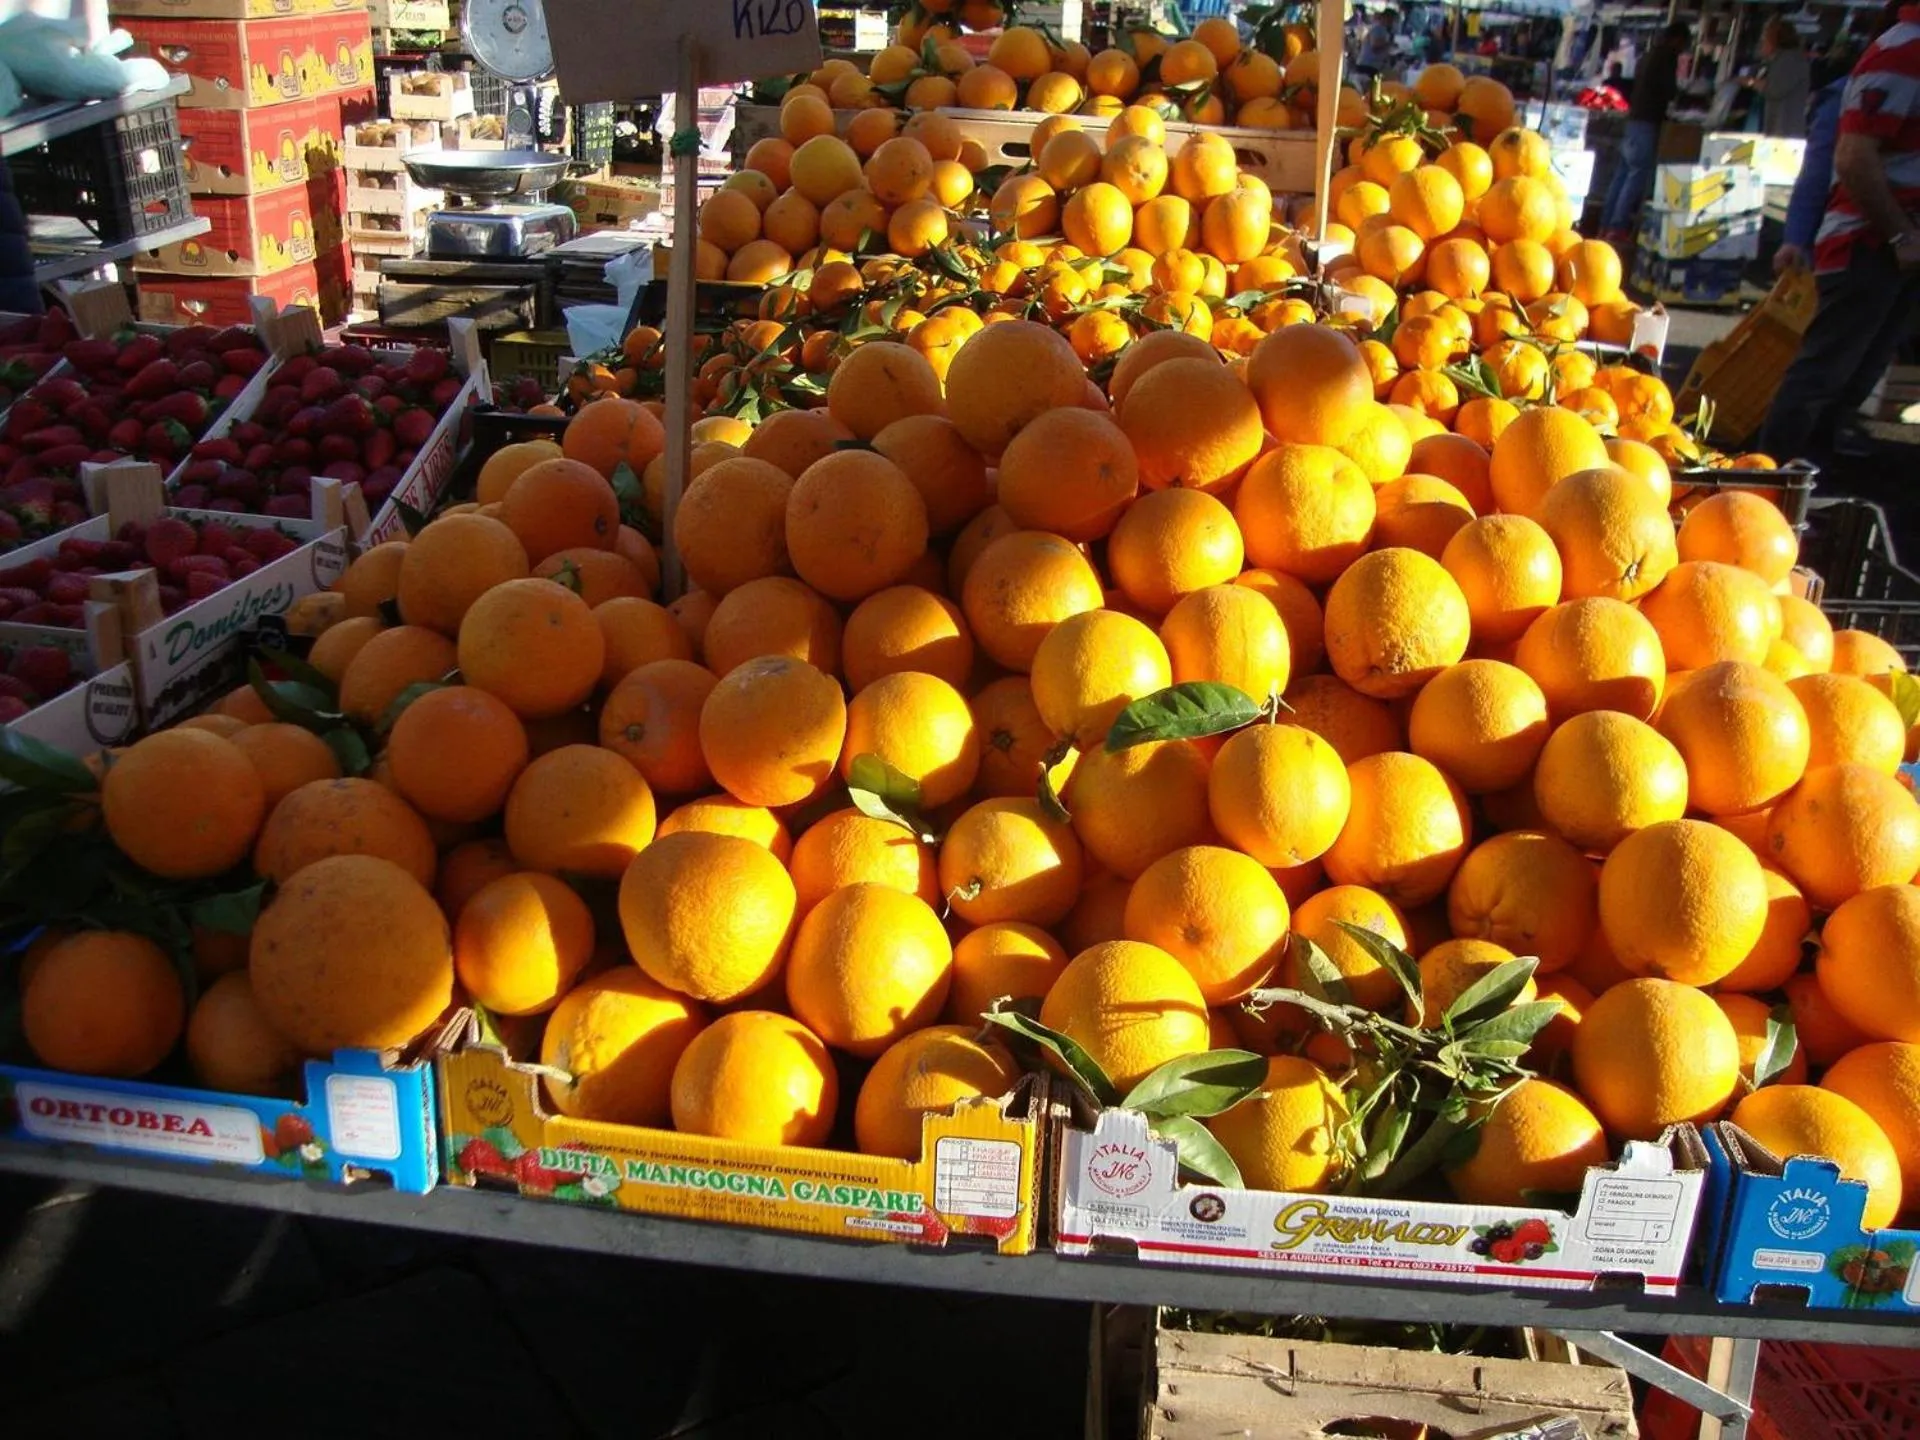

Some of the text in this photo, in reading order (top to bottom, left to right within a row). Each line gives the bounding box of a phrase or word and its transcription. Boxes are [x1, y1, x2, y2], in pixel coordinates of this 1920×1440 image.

[30, 1096, 214, 1137] ORTOBEA
[1096, 1144, 1145, 1161] ITALIA
[540, 1148, 621, 1178] DITTA
[624, 1159, 788, 1199] MANGOGNA
[793, 1180, 925, 1213] GASPARE
[774, 1166, 879, 1185] ORTOFRUTTICOLI
[1777, 1187, 1828, 1208] ITALIA
[1332, 1204, 1411, 1218] AZIENDA AGRICOLA
[1257, 1250, 1289, 1261] SESSA
[1289, 1252, 1340, 1264] AURUNCA
[1340, 1255, 1361, 1267] (CE)
[1367, 1257, 1385, 1268] Tel.
[1392, 1259, 1411, 1269] Fax
[1593, 1246, 1615, 1254] ZONA
[1592, 1255, 1614, 1263] ITALIA
[1618, 1256, 1655, 1265] CAMPANIA
